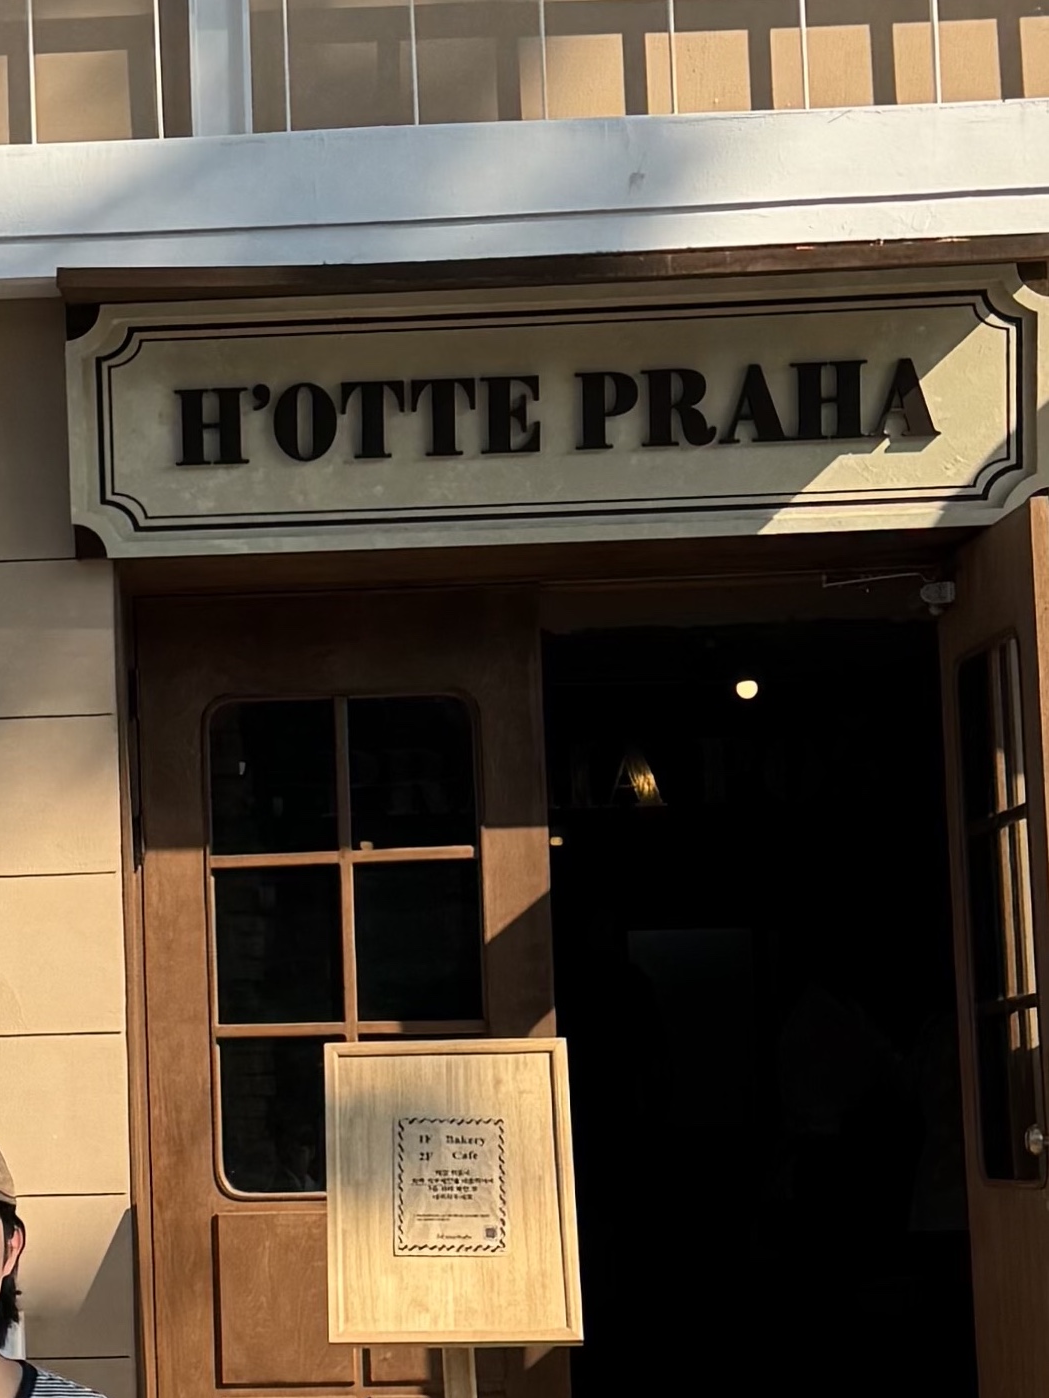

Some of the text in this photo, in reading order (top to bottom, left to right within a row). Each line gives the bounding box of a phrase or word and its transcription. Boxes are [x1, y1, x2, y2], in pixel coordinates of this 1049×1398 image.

[574, 357, 943, 451] PRAHA
[446, 1134, 485, 1147] Bakery
[452, 1150, 478, 1160] Cafe
